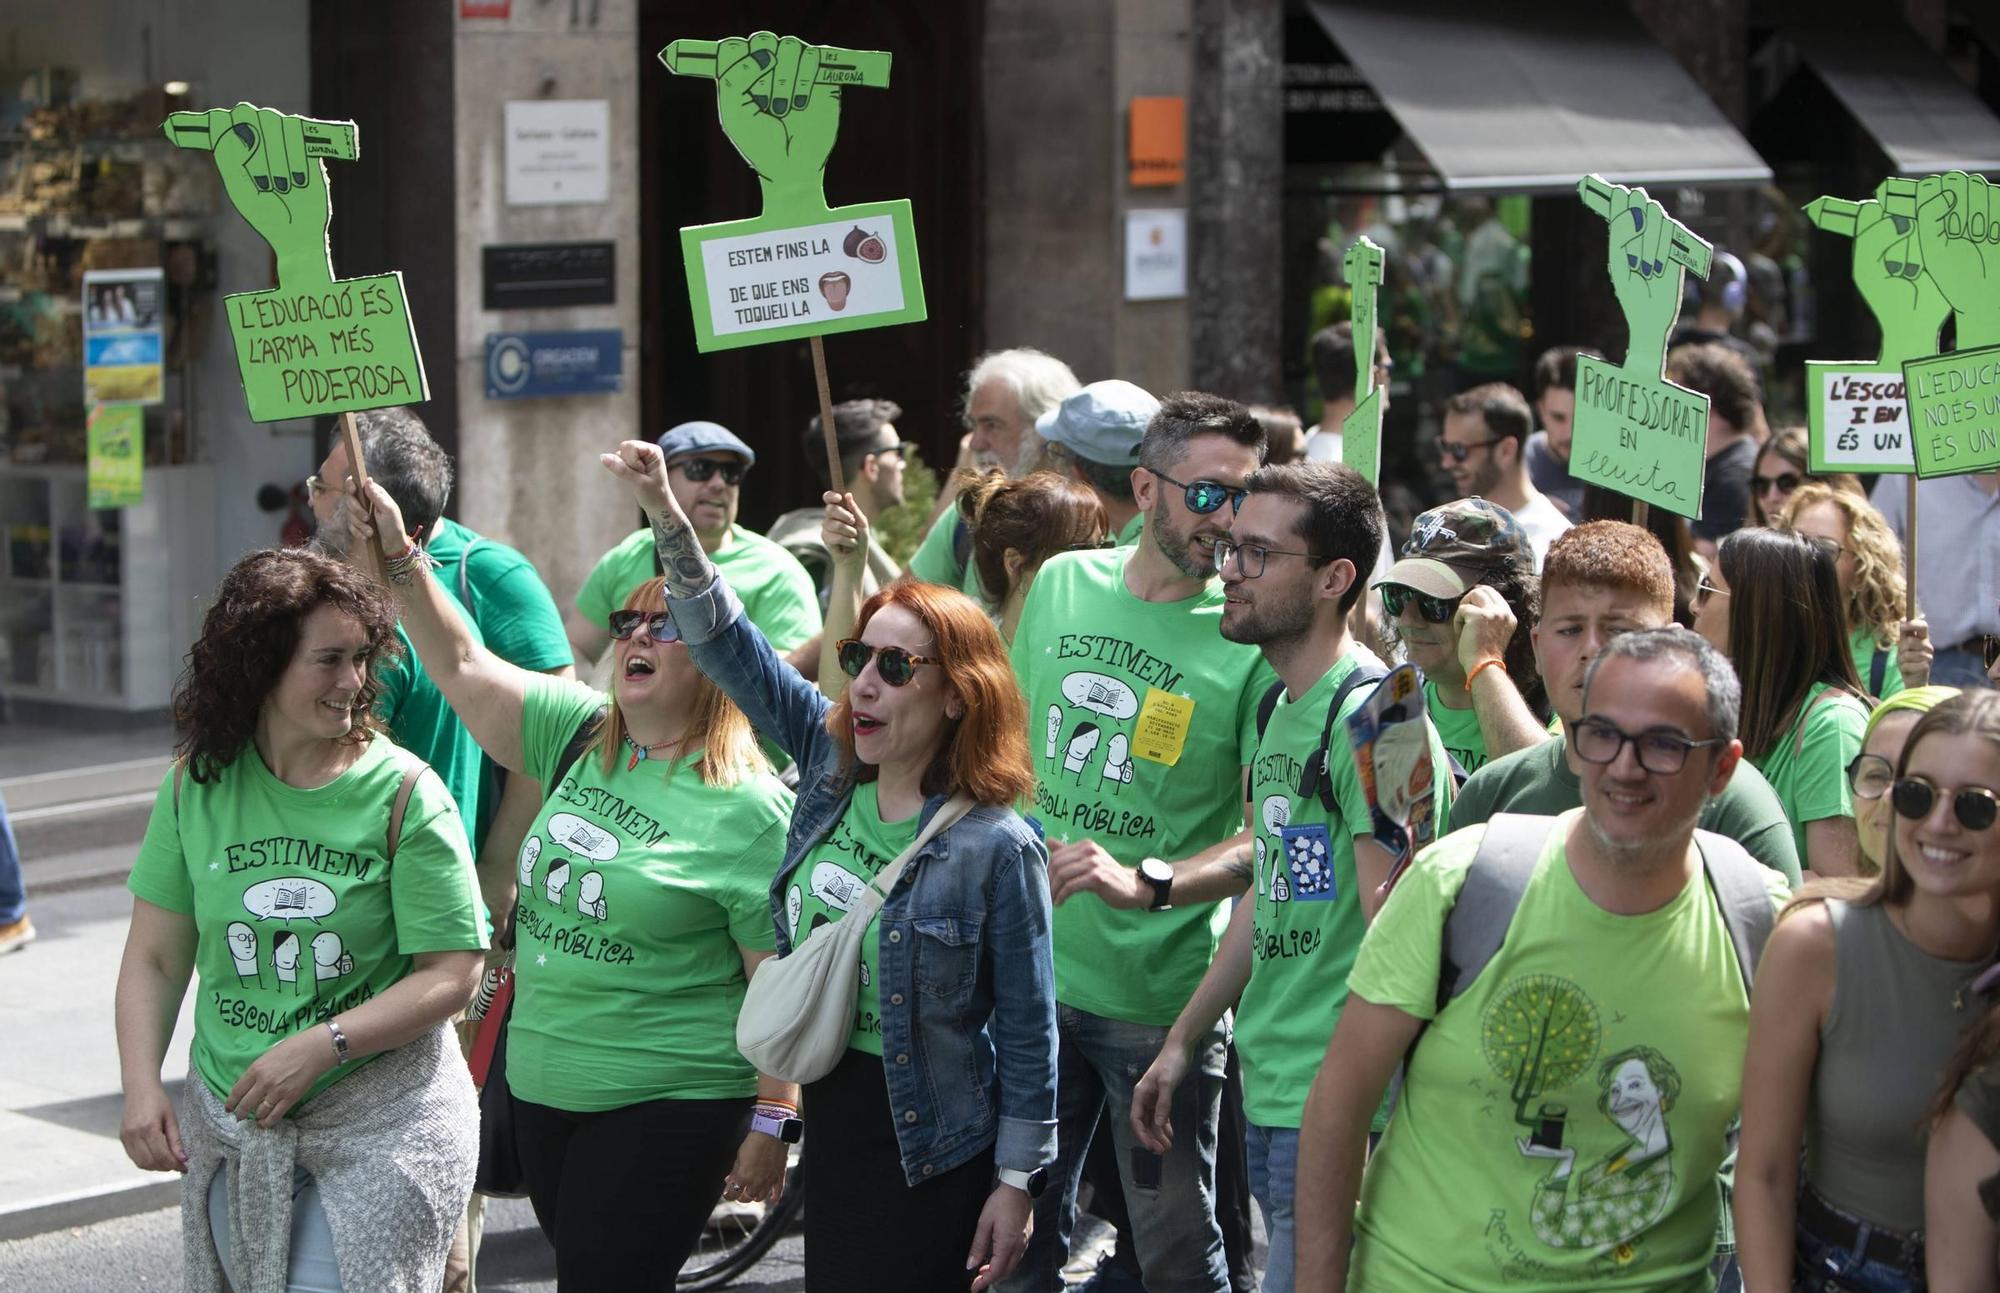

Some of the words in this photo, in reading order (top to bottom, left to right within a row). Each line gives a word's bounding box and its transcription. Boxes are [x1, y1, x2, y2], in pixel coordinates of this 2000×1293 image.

[728, 245, 773, 267] ESTEM
[776, 241, 808, 260] FINS
[812, 238, 831, 255] LA
[239, 286, 352, 329] L'EDUCACIÓ
[360, 284, 394, 317] ÉS
[729, 286, 748, 303] DE
[752, 281, 777, 300] QUE
[782, 278, 810, 296] ENS
[735, 303, 788, 325] TOQUEU
[792, 300, 810, 316] LA
[249, 335, 318, 364] L'ARMA
[330, 324, 374, 354] MÉS
[282, 365, 411, 404] PODEROSA
[1583, 366, 1704, 444] PROFESSORAT
[1850, 406, 1869, 424] I
[1873, 406, 1902, 424] EN
[1620, 427, 1637, 451] EN
[1837, 428, 1859, 451] ÉS
[1874, 433, 1902, 450] UN
[1932, 433, 1958, 462] ÉS
[1968, 427, 1997, 453] UN
[1057, 635, 1184, 692] ESTIMEM
[558, 777, 670, 848] ESTIMEM
[224, 836, 375, 881] ESTIMEM
[516, 904, 553, 944] SCOLA
